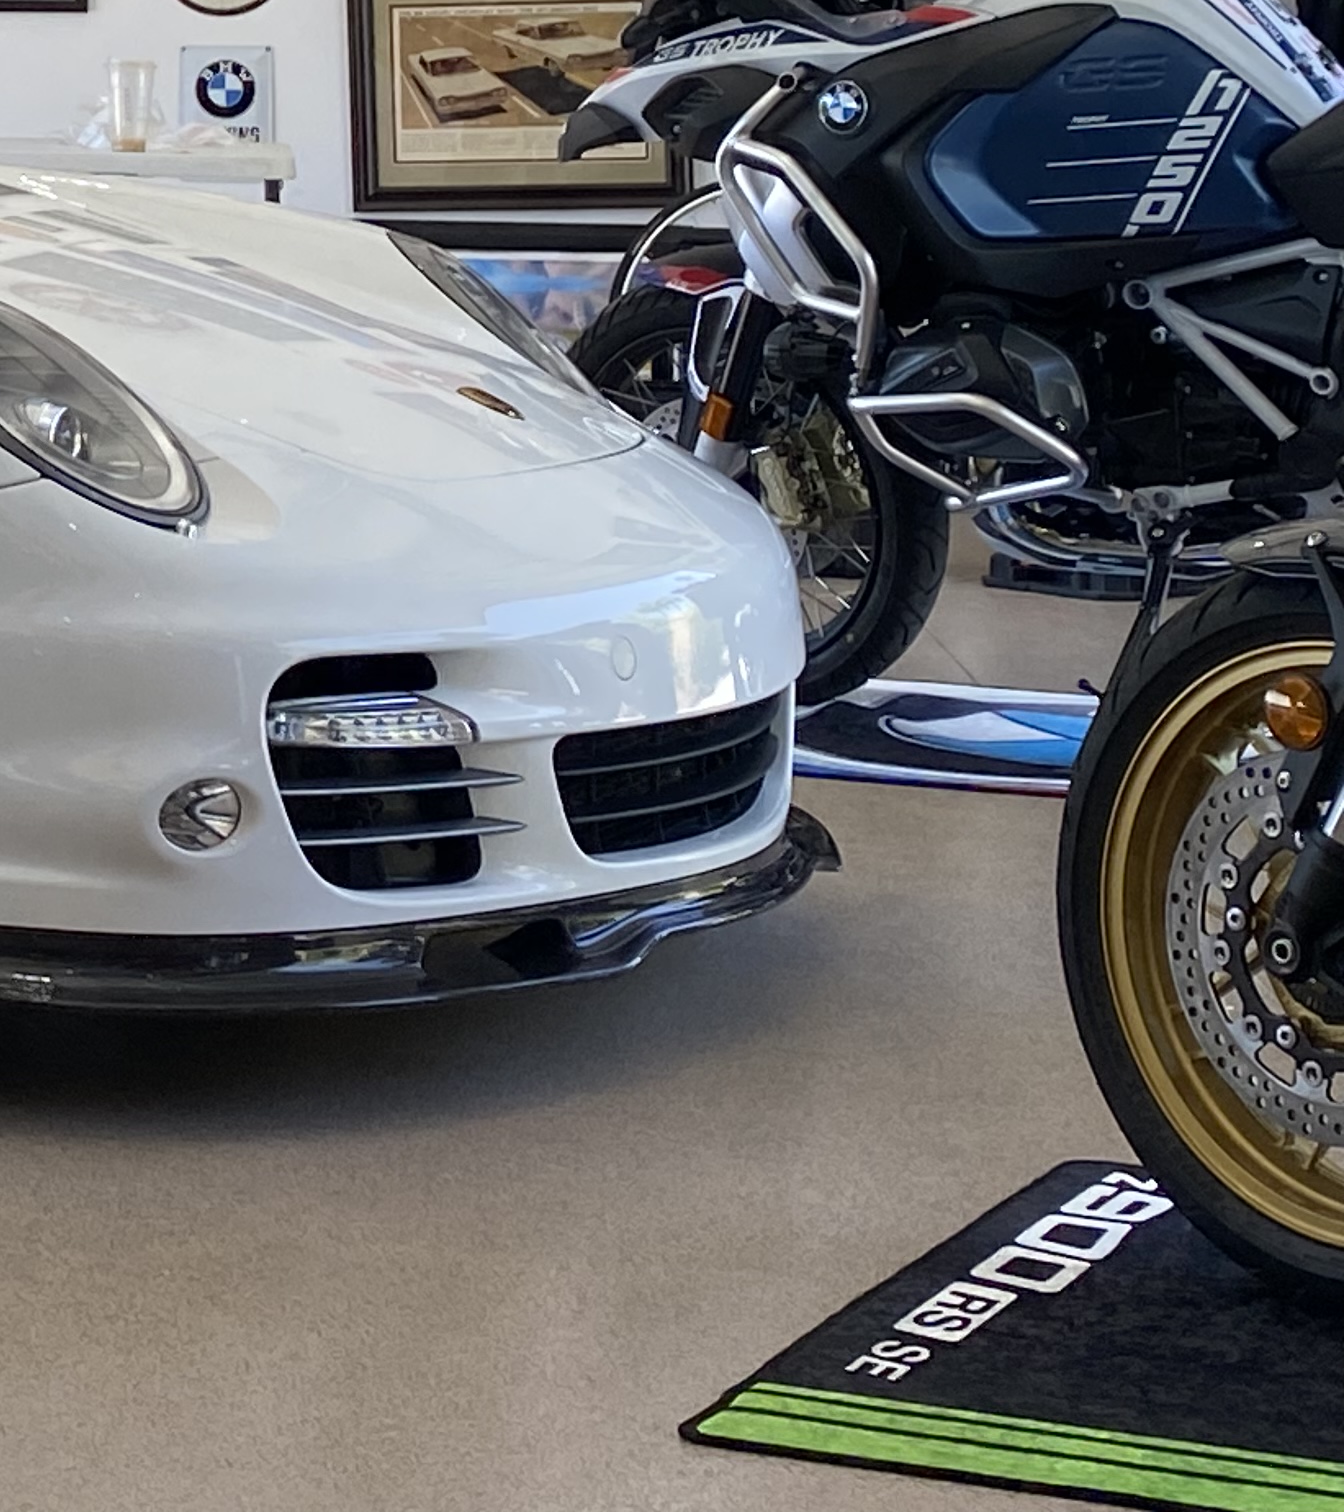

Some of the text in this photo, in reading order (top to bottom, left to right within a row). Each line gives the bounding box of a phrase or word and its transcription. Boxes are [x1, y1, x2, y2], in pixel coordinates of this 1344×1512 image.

[690, 29, 785, 58] TROPHY
[201, 61, 251, 82] BMW
[845, 1339, 930, 1381] SE
